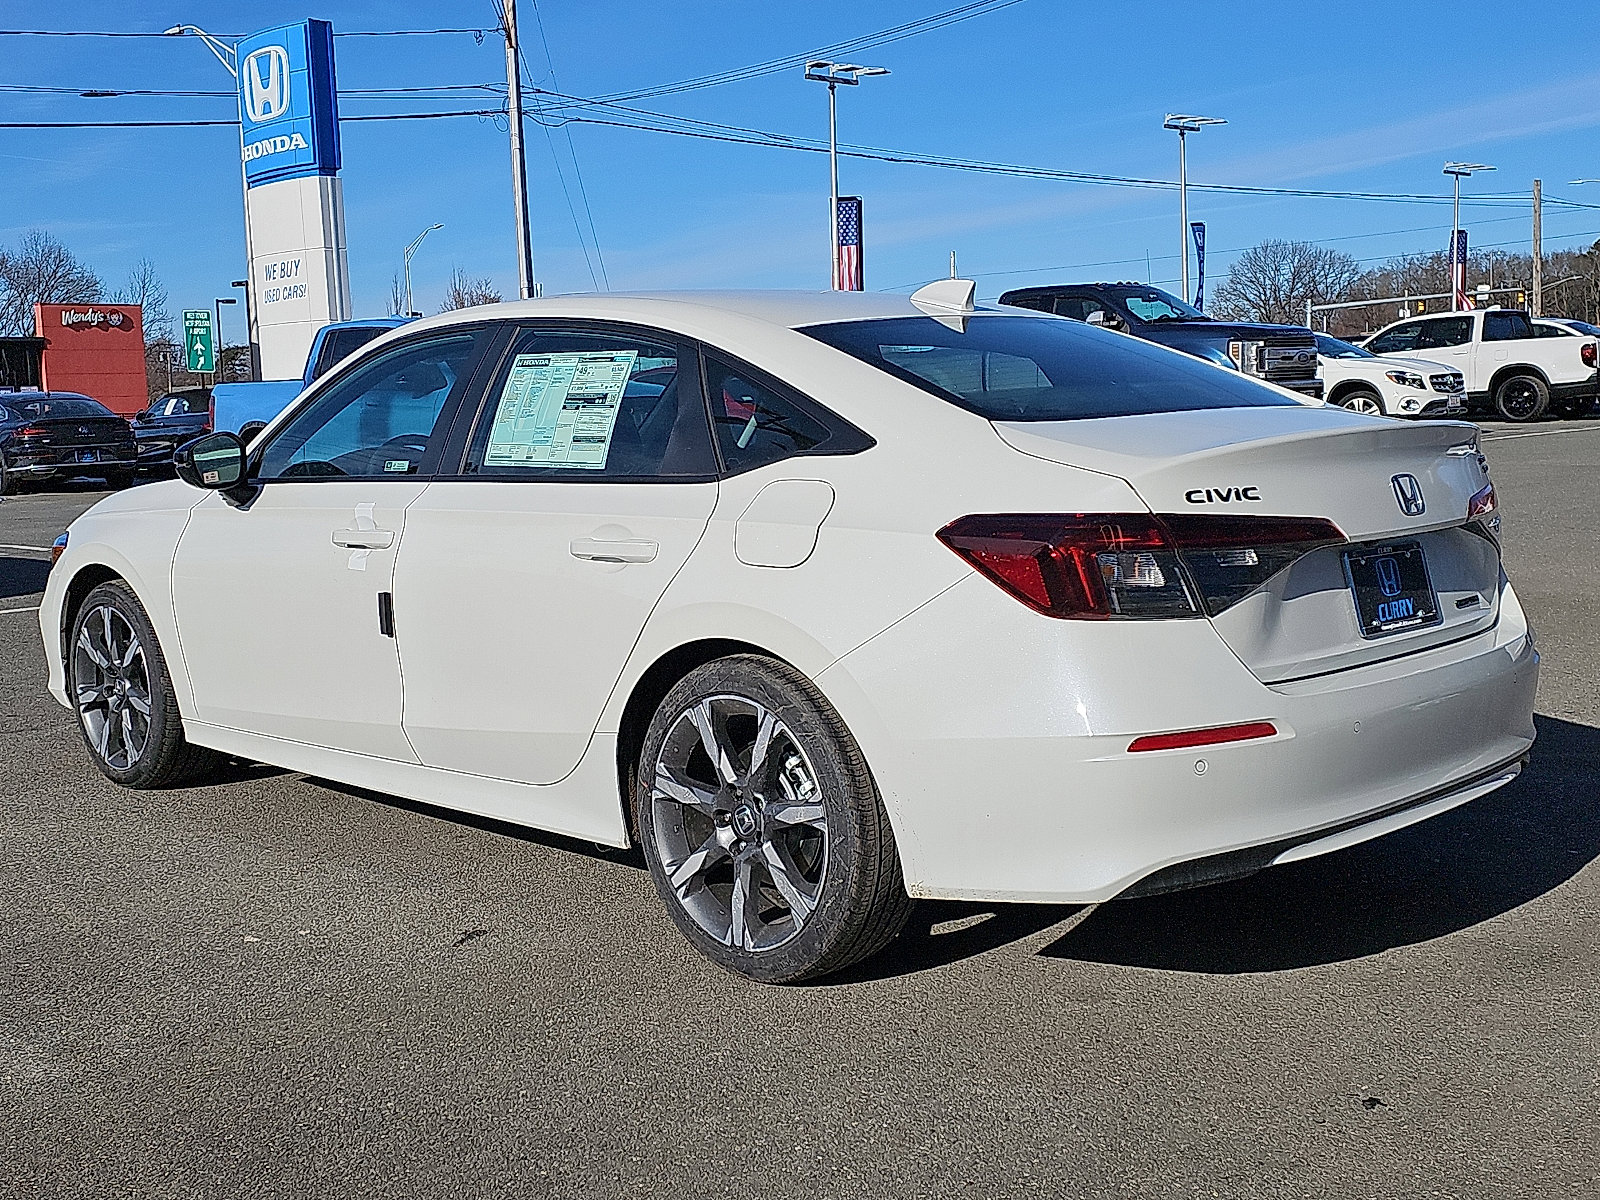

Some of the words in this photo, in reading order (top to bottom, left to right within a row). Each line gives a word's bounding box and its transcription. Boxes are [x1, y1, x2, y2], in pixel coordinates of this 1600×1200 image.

[242, 133, 308, 162] HONDA
[264, 263, 278, 281] WE
[280, 259, 301, 279] BUY
[264, 288, 281, 303] USED
[282, 284, 307, 301] CARS!
[61, 308, 104, 325] Wendy's
[1185, 487, 1262, 504] CIVIC
[1378, 597, 1414, 622] CURRY
